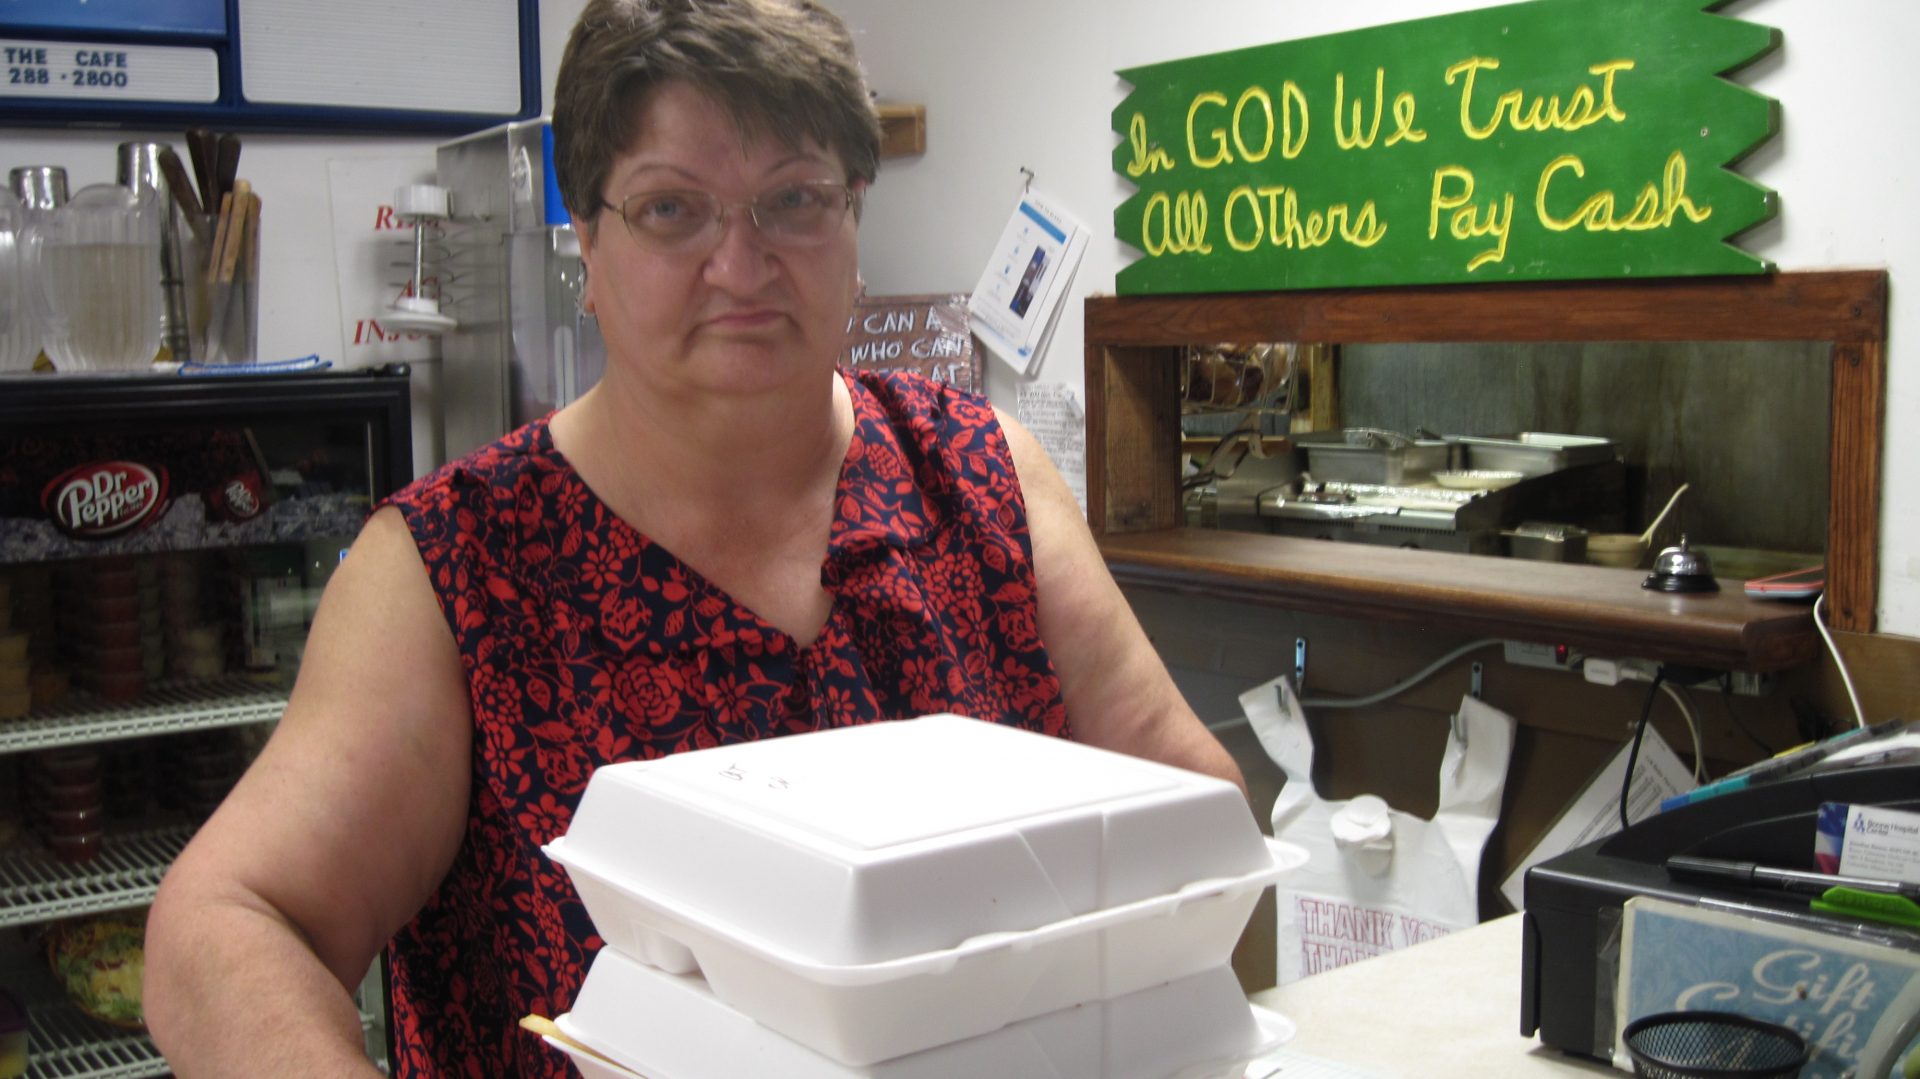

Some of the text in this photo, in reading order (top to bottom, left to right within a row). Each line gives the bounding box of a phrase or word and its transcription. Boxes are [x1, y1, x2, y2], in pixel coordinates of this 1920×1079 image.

[4, 47, 128, 68] THE CAFE
[9, 67, 49, 84] 288
[1126, 55, 1636, 177] In GOD We Trust
[1142, 149, 1713, 272] All Others Pay Cash
[863, 310, 915, 335] CAN
[851, 336, 965, 365] WHO CAN
[92, 470, 128, 499] Dr
[57, 478, 153, 530] Pepper
[1301, 899, 1451, 951] THANK YO
[1303, 940, 1380, 976] THA
[1752, 948, 1876, 1016] Gift
